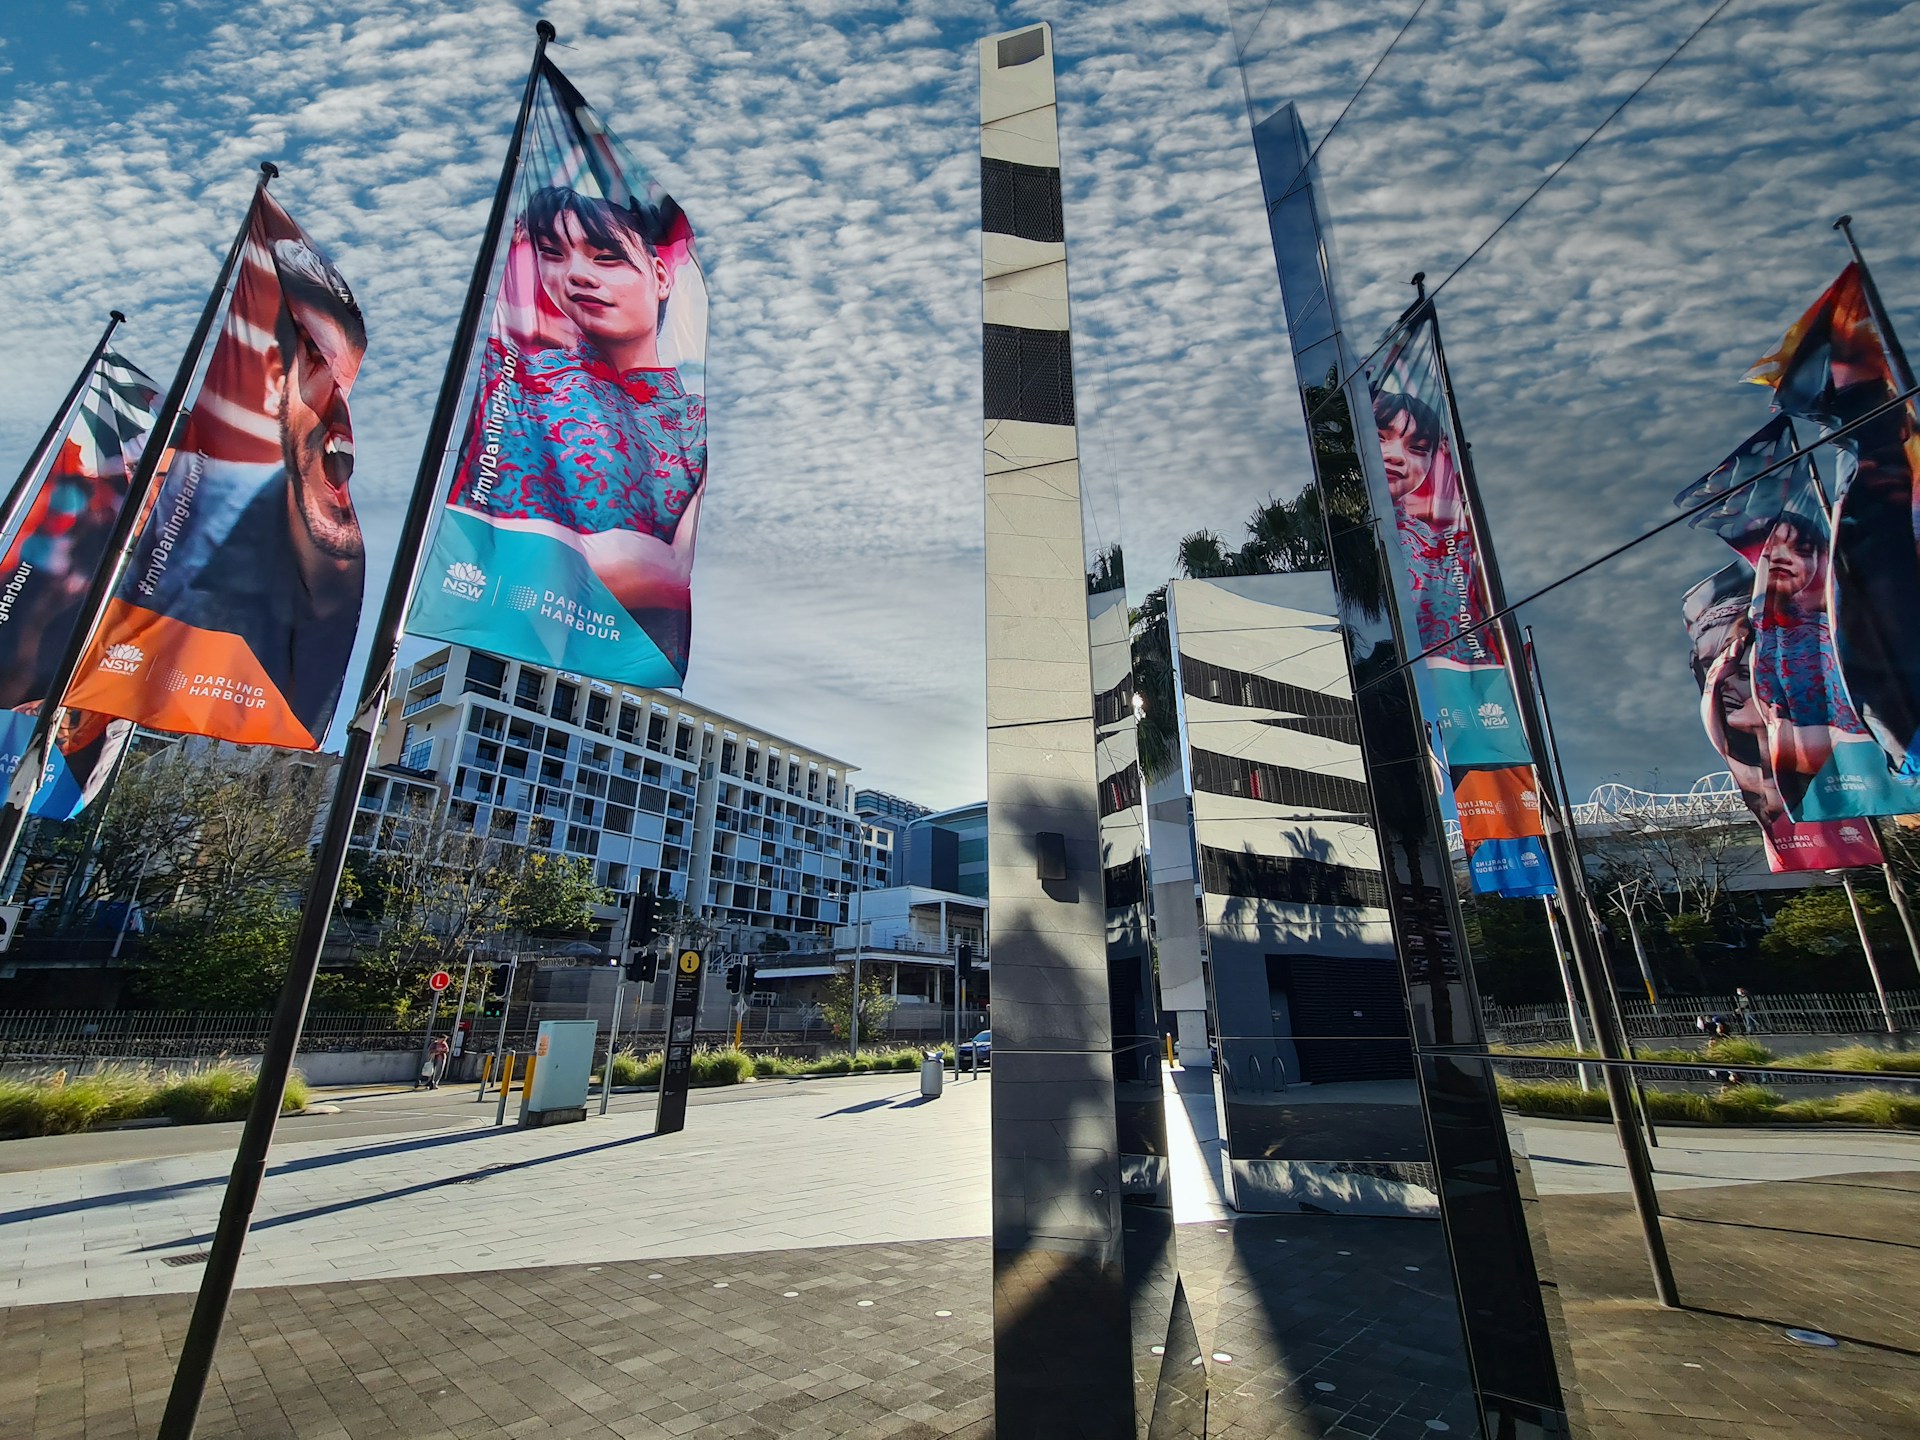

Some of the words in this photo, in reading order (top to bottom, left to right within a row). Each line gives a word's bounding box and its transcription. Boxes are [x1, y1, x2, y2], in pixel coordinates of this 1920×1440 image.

[471, 338, 520, 505] #myDarlingHarbour
[138, 448, 209, 596] #myDarlingHarbour
[0, 561, 33, 625] gHarbour
[443, 577, 483, 598] NSW
[540, 604, 621, 641] HARBOUR
[543, 590, 616, 627] DARLING
[100, 657, 140, 672] NSW
[189, 686, 266, 709] HARBOUR
[194, 674, 264, 697] DARLING
[435, 975, 444, 987] L
